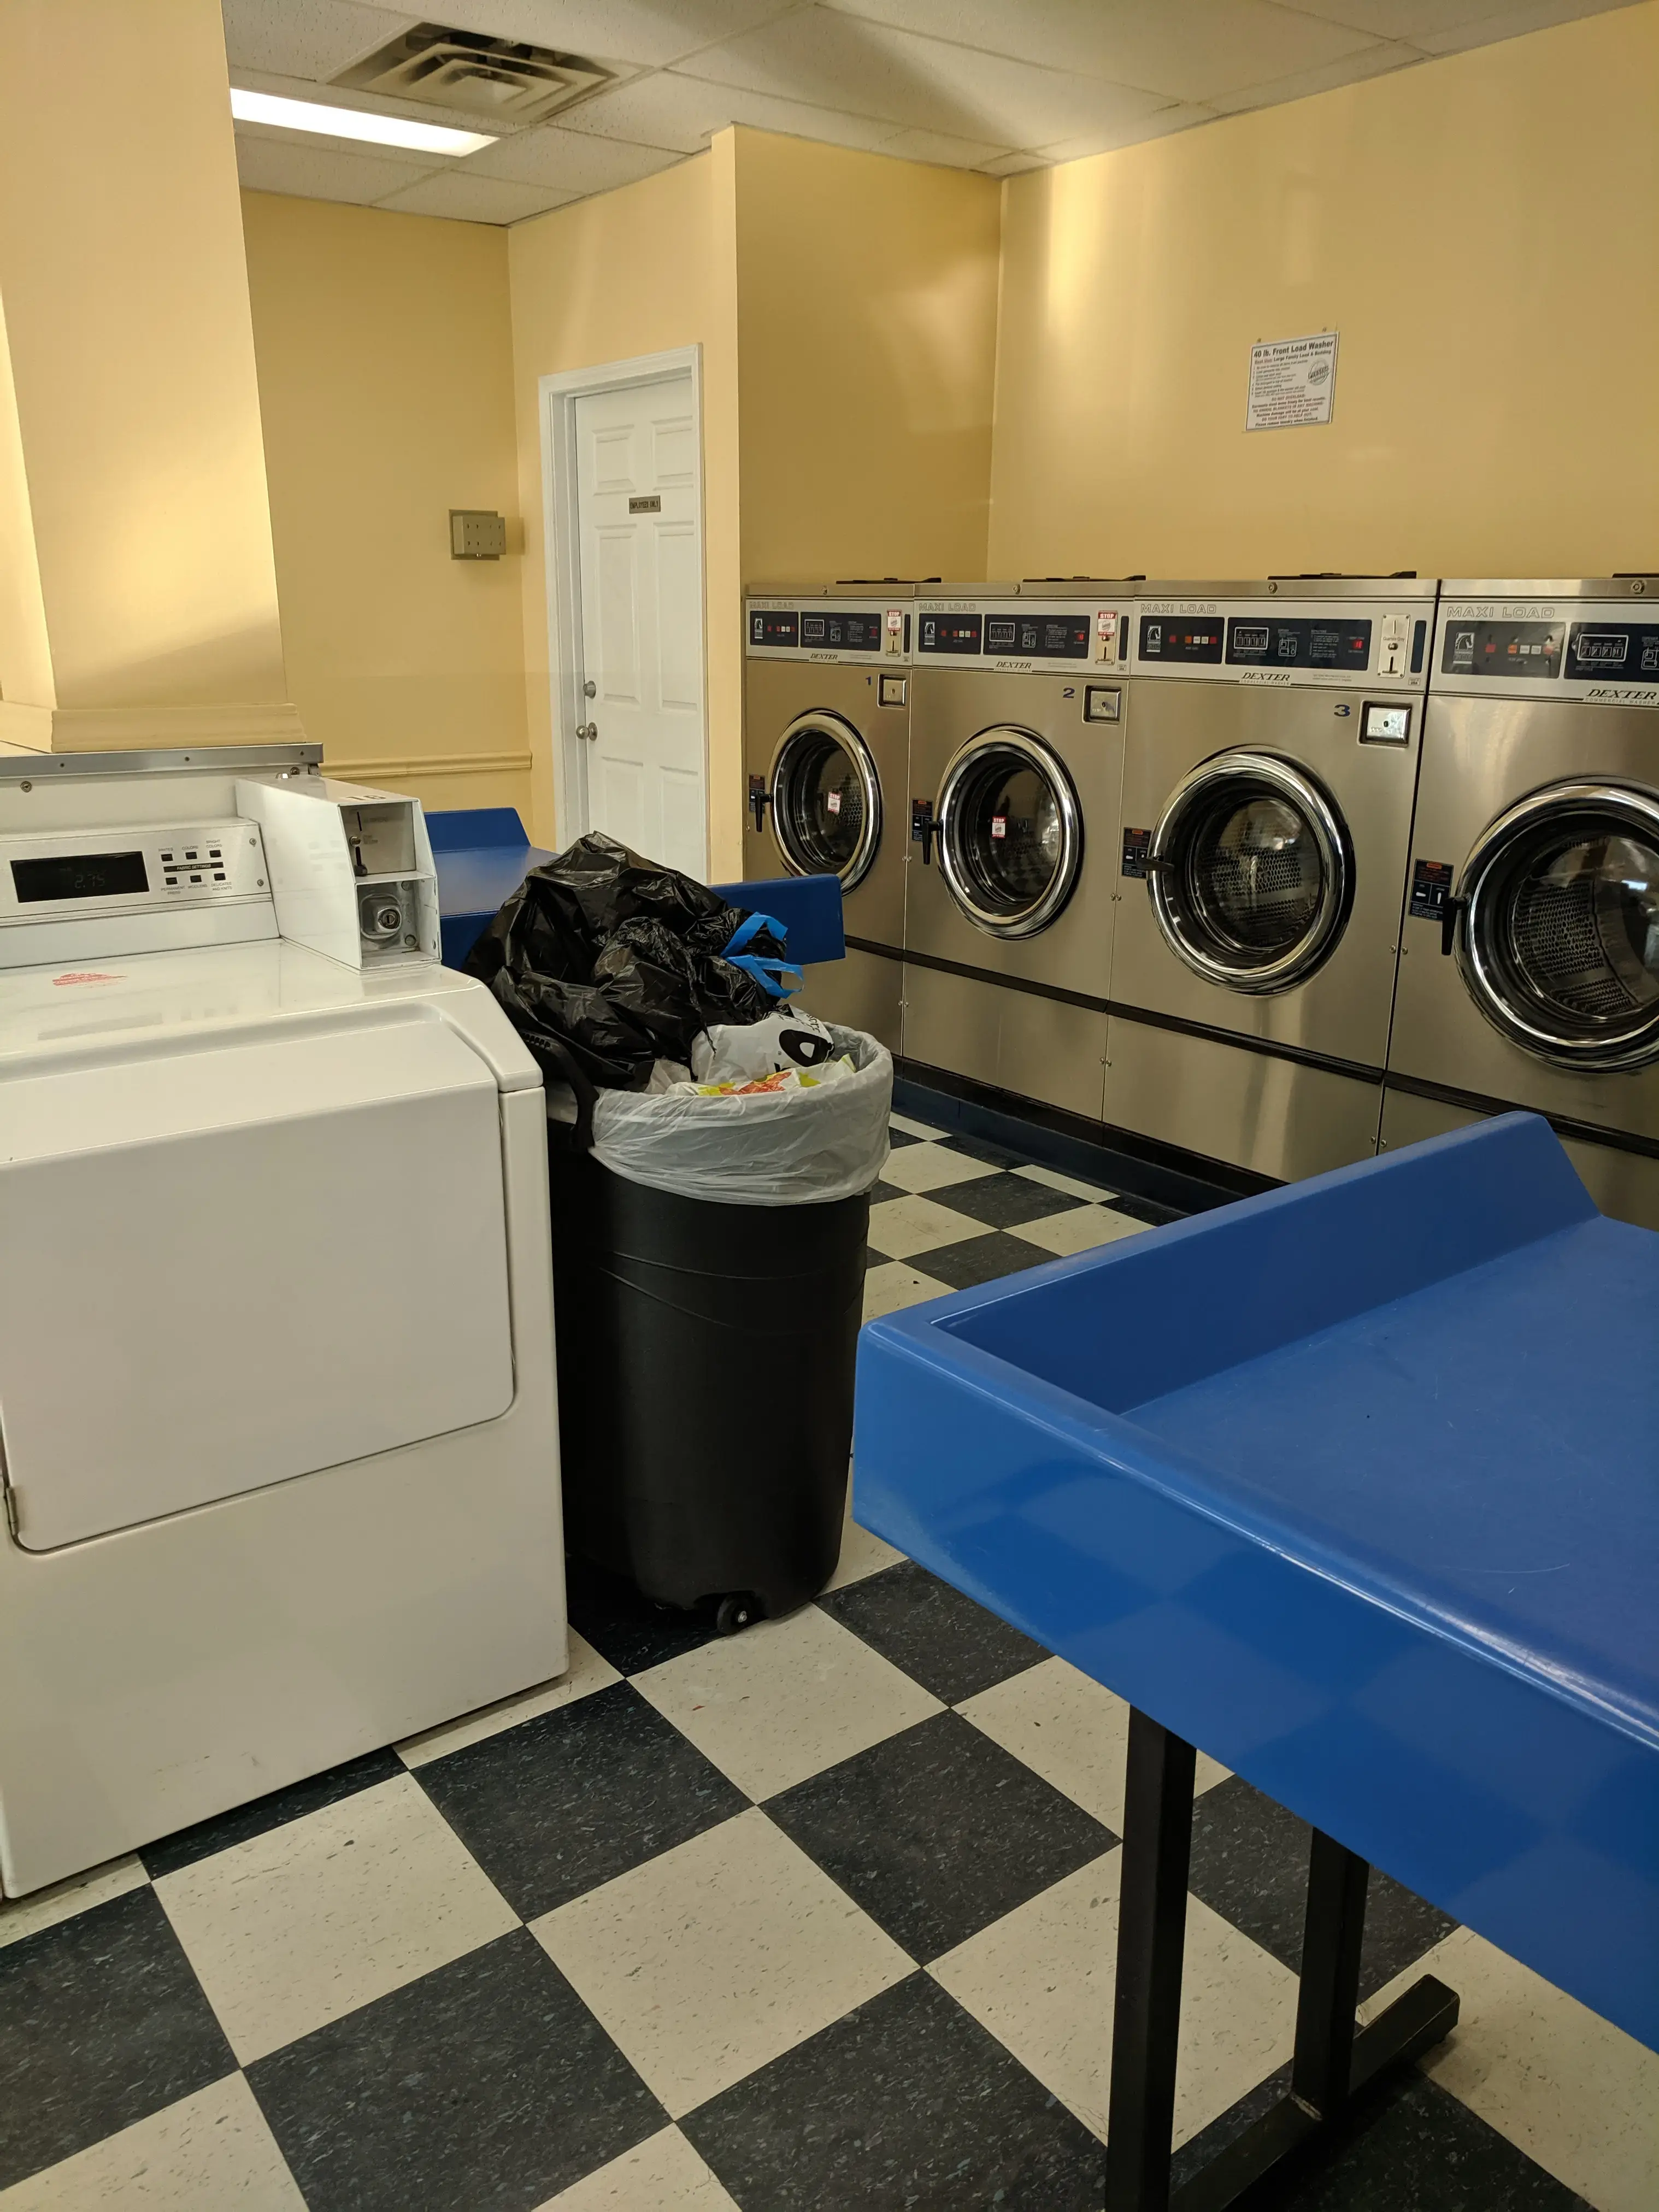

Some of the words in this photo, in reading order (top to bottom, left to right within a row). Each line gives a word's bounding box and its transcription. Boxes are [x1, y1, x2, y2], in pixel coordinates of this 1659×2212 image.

[1254, 350, 1262, 358] 40
[1263, 349, 1271, 357] lb.
[1273, 346, 1290, 356] Front
[1291, 343, 1307, 353] Load
[1309, 340, 1334, 350] Washer
[919, 603, 944, 611] MAXI
[948, 603, 976, 612] LOAD
[1140, 603, 1174, 614] MAXI
[1179, 604, 1217, 614] LOAD
[1447, 607, 1494, 618] MAXI
[1502, 607, 1555, 619] LOAD
[996, 661, 1032, 669] DEXTER
[865, 676, 872, 686] 1
[1241, 672, 1291, 681] DEXTER
[1062, 687, 1075, 699] 2
[1586, 689, 1657, 700] DEXTER
[1333, 704, 1351, 717] 3
